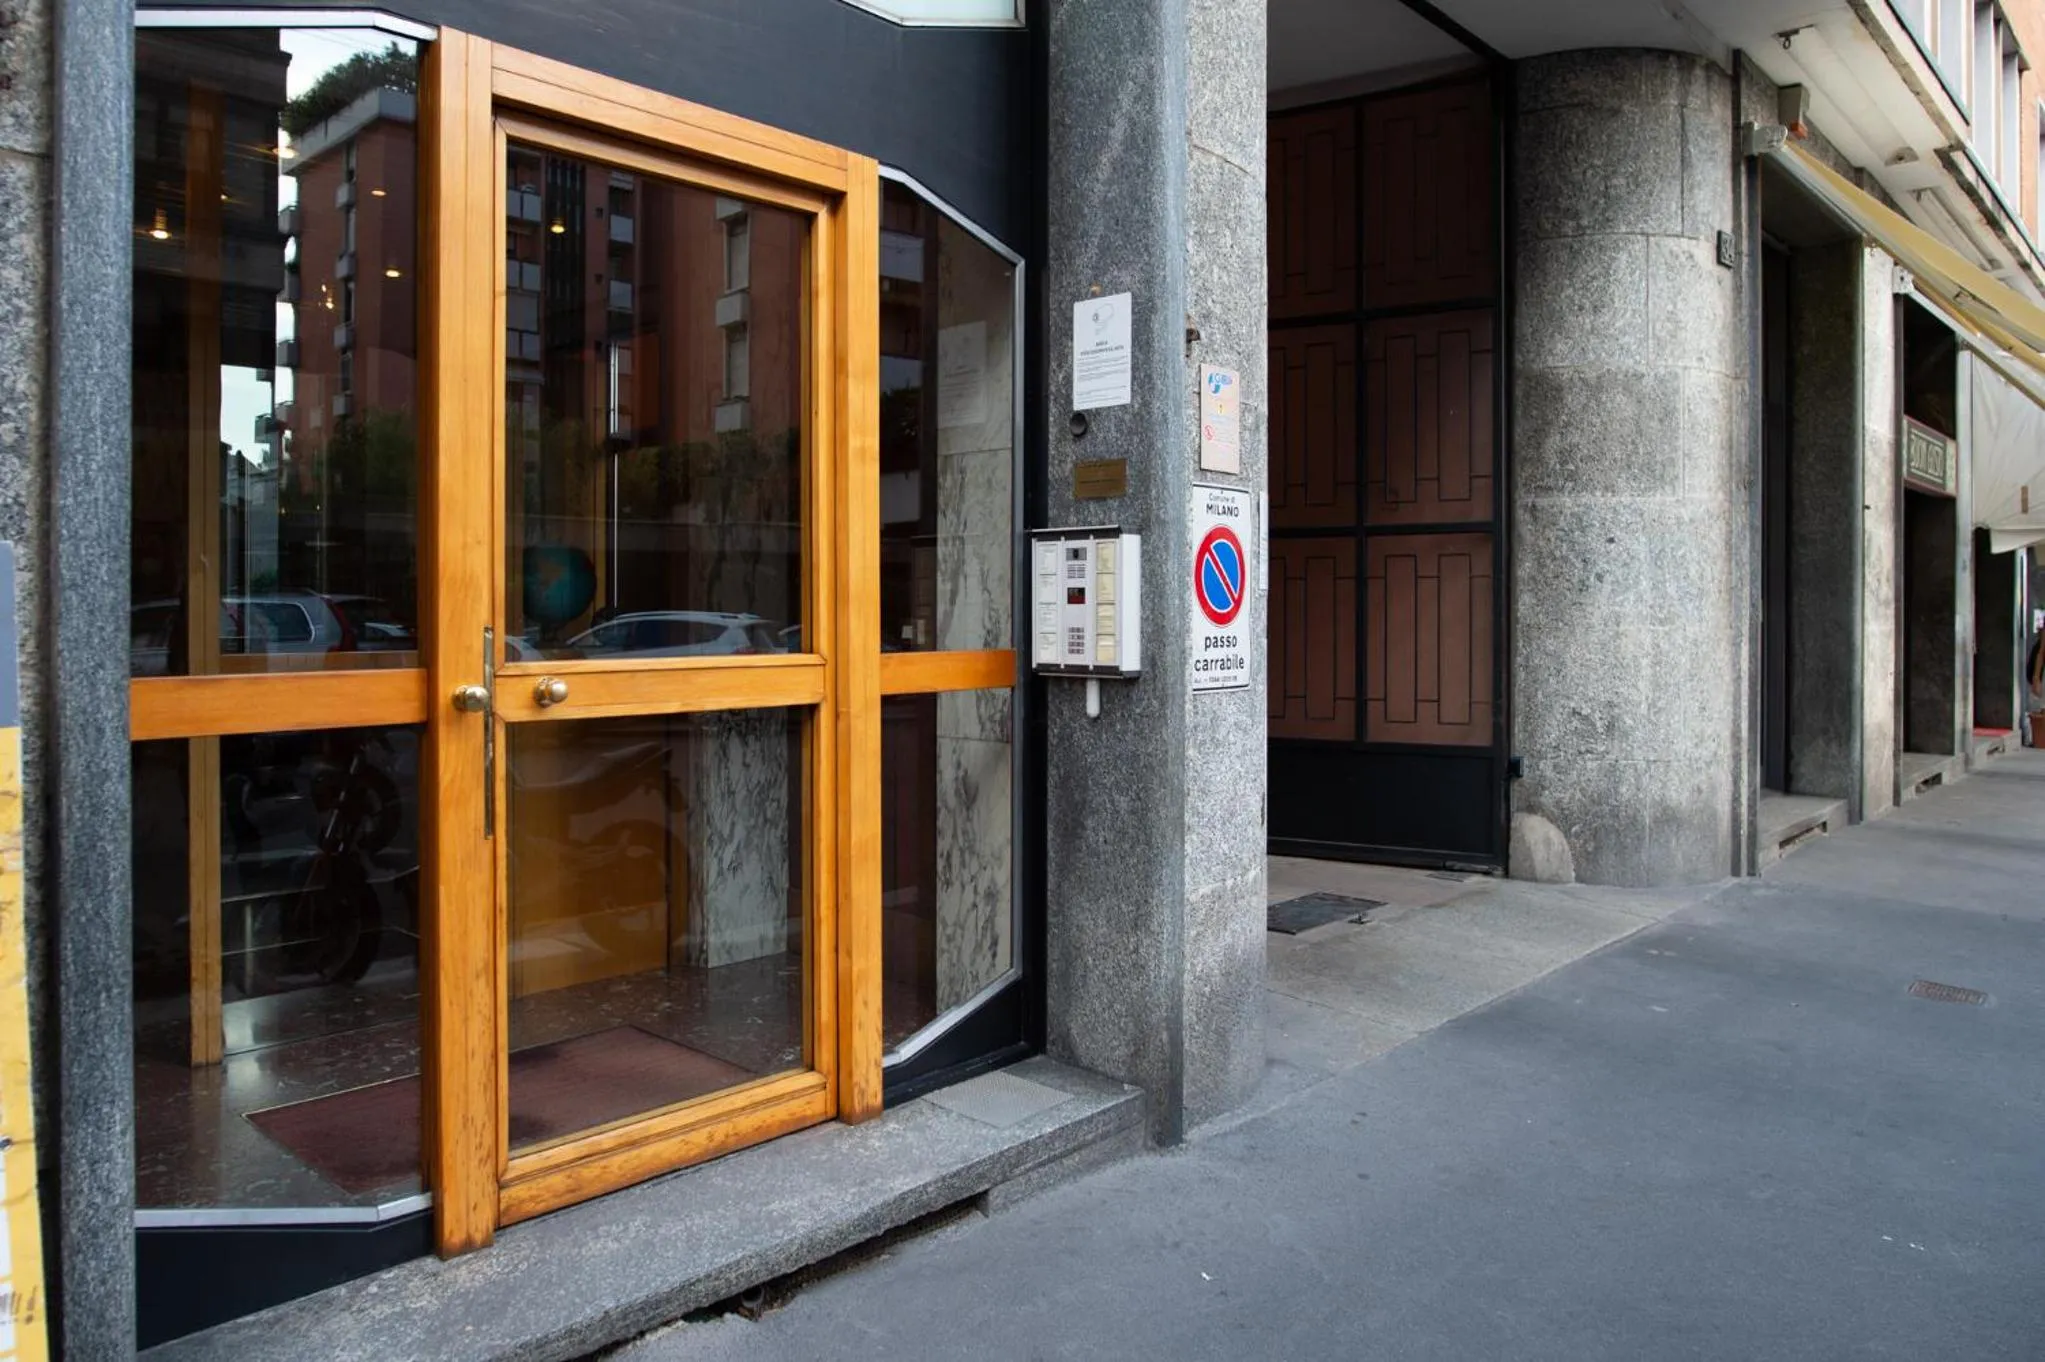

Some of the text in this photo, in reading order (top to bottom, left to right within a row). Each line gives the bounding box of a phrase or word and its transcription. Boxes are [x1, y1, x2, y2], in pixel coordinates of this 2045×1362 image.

[1206, 503, 1239, 518] MILANO
[1204, 635, 1237, 651] passo
[1194, 653, 1244, 671] carrabile
